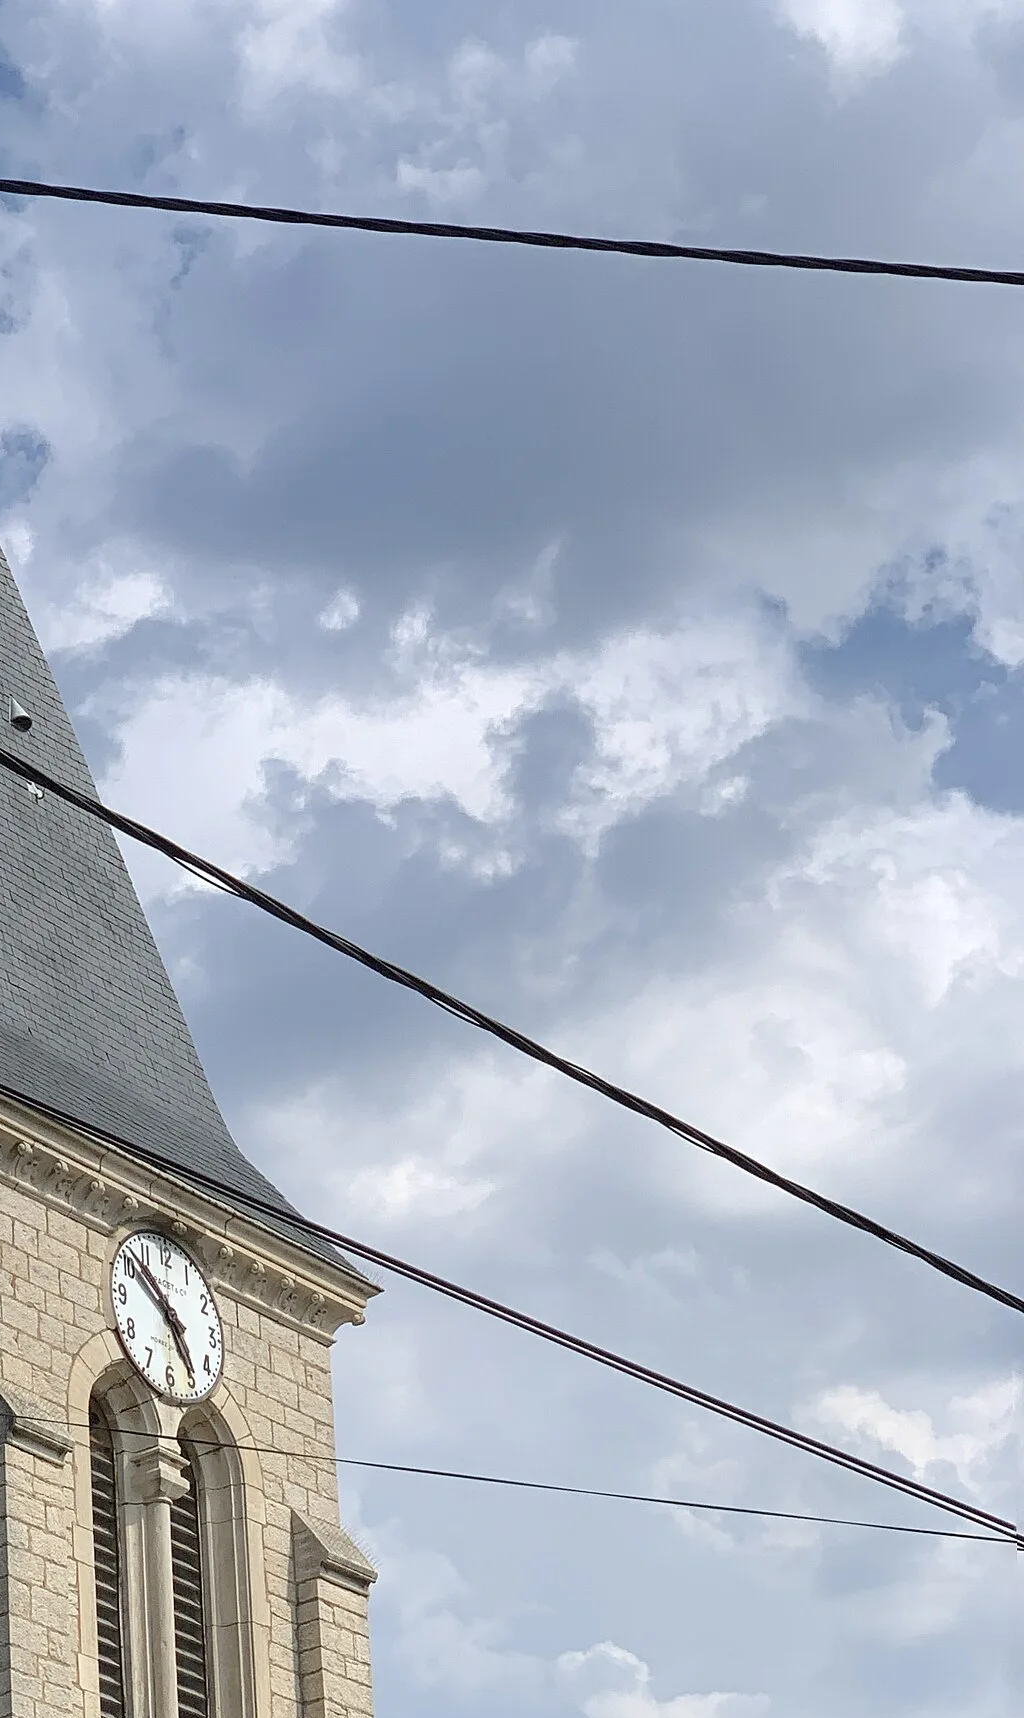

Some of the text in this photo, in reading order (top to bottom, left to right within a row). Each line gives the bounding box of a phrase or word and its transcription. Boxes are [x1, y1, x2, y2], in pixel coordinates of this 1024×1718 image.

[141, 1243, 149, 1266] 11
[160, 1245, 172, 1269] 12
[124, 1253, 134, 1279] 10
[185, 1265, 188, 1285] 1
[118, 1283, 127, 1305] 9
[200, 1293, 209, 1316] 2
[127, 1317, 135, 1339] 8
[208, 1326, 216, 1348] 3
[145, 1346, 153, 1368] 7
[203, 1355, 211, 1376] 4
[166, 1365, 174, 1387] 6
